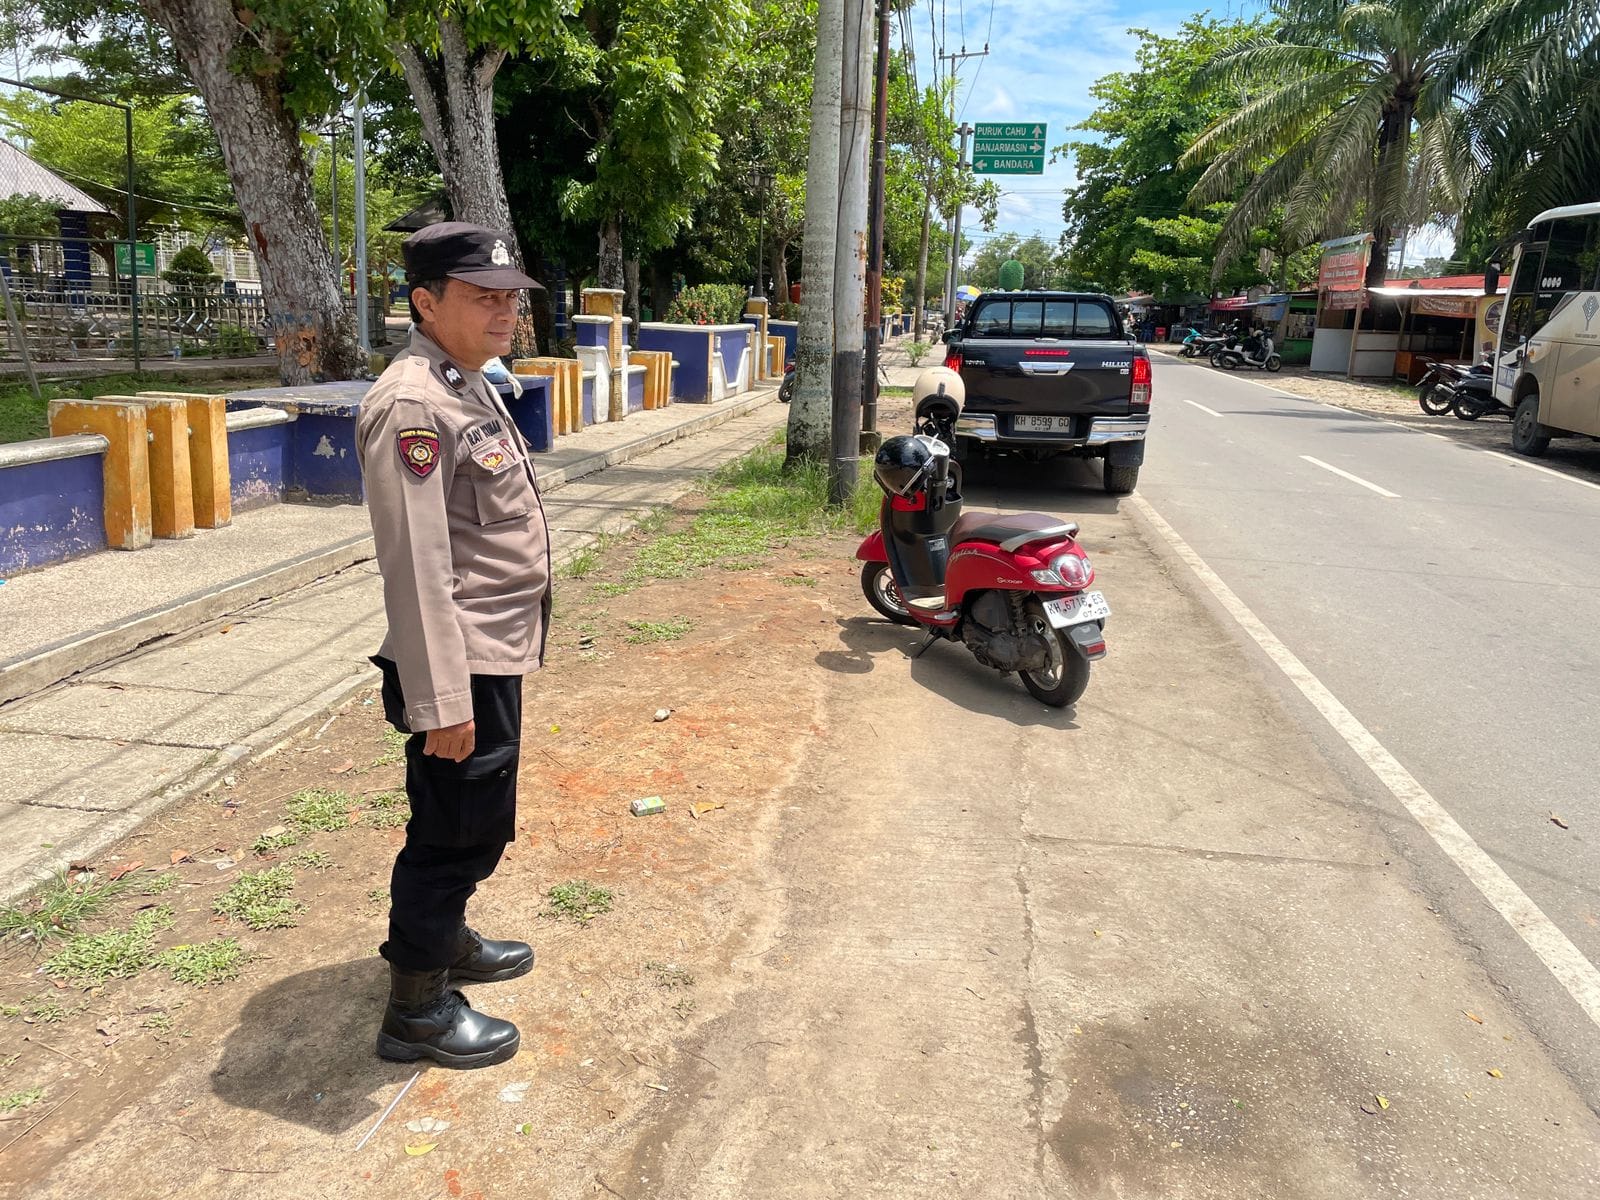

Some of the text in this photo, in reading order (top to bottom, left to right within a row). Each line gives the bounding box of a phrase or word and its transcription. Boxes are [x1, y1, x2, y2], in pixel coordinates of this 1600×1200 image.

[977, 127, 1026, 136] PURUK CAHU
[975, 143, 1027, 152] BANJARMASIN
[994, 160, 1034, 169] BANDARA
[1015, 415, 1026, 425] KH
[1031, 416, 1053, 427] 8599
[1047, 593, 1104, 615] KH 6716 ES
